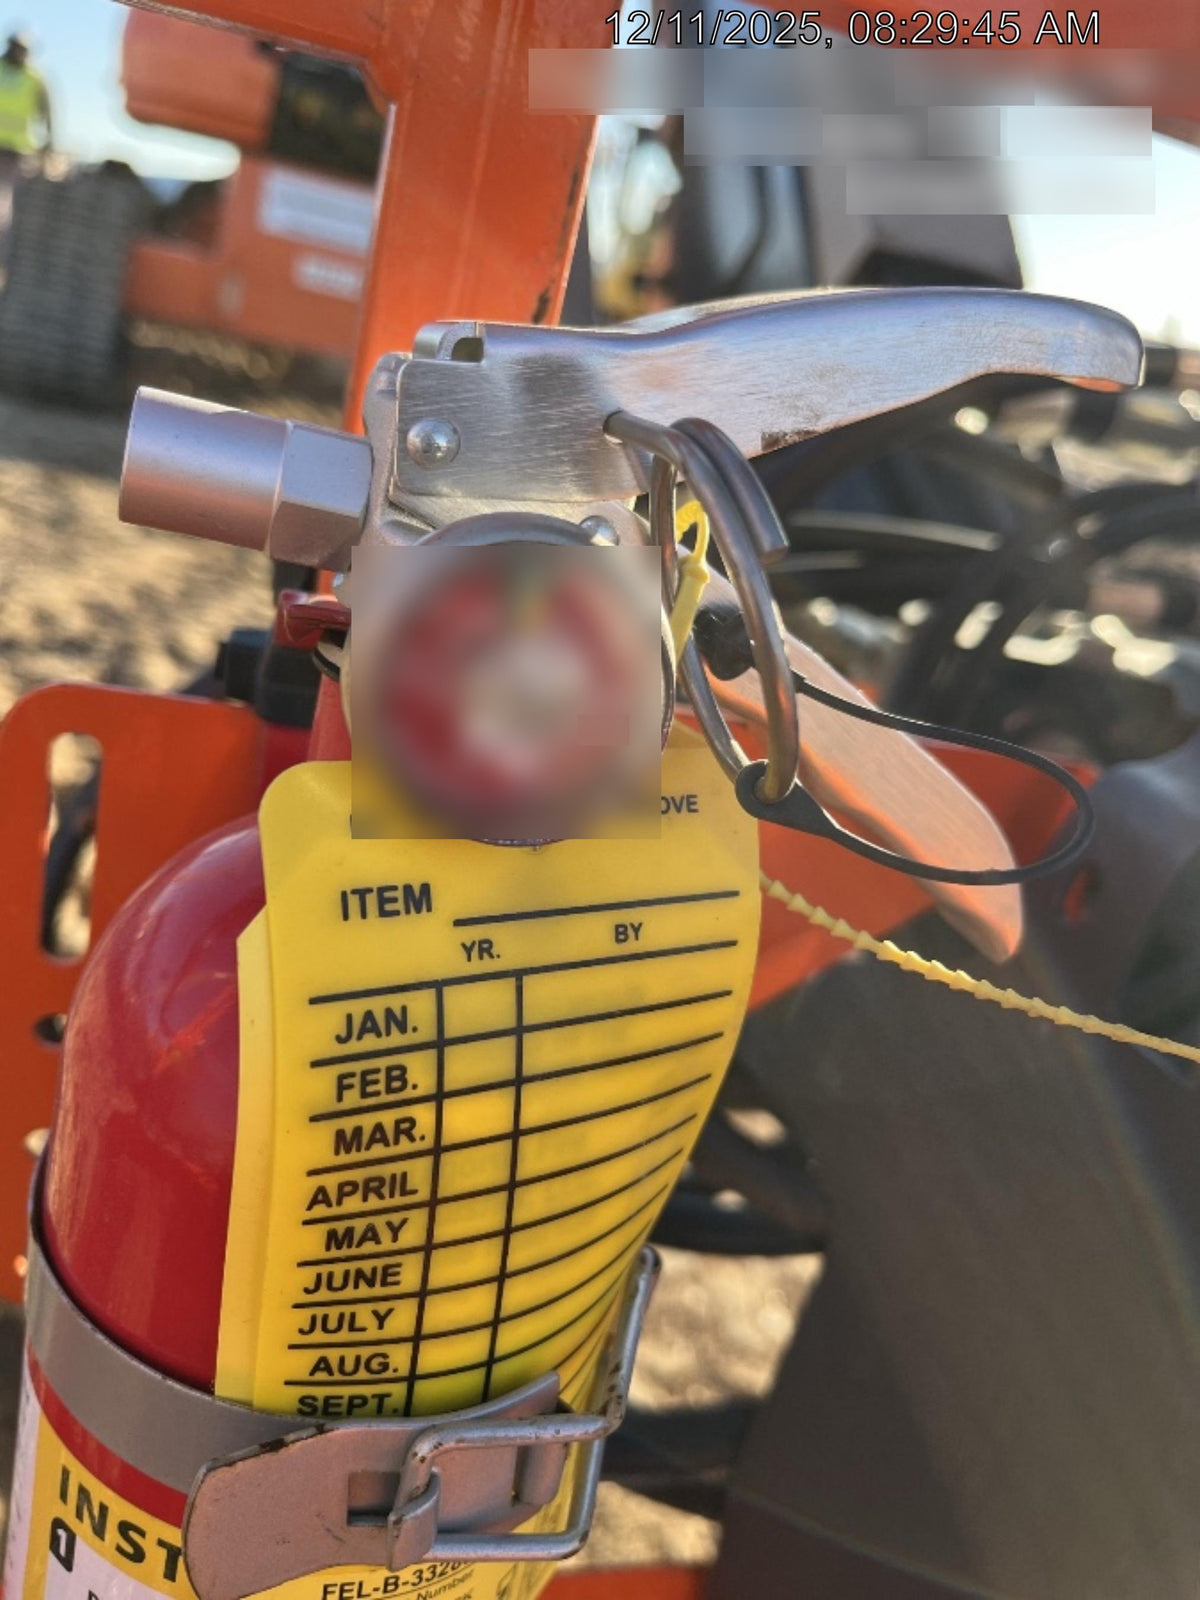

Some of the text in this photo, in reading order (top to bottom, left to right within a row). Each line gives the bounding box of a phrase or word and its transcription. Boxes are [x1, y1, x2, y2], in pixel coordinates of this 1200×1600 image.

[340, 882, 433, 922] ITEM
[461, 922, 643, 963] YR. BY
[335, 1005, 418, 1044] JAN.
[336, 1065, 418, 1102] FEB.
[333, 1116, 426, 1156] MAR.
[306, 1171, 418, 1211] APRIL
[325, 1217, 409, 1252] MAY
[303, 1263, 403, 1295] JUNE
[298, 1307, 395, 1336] JULY
[309, 1352, 399, 1377] AUG.
[296, 1392, 398, 1417] SEPT.
[321, 1561, 473, 1600] FEL-B-332
